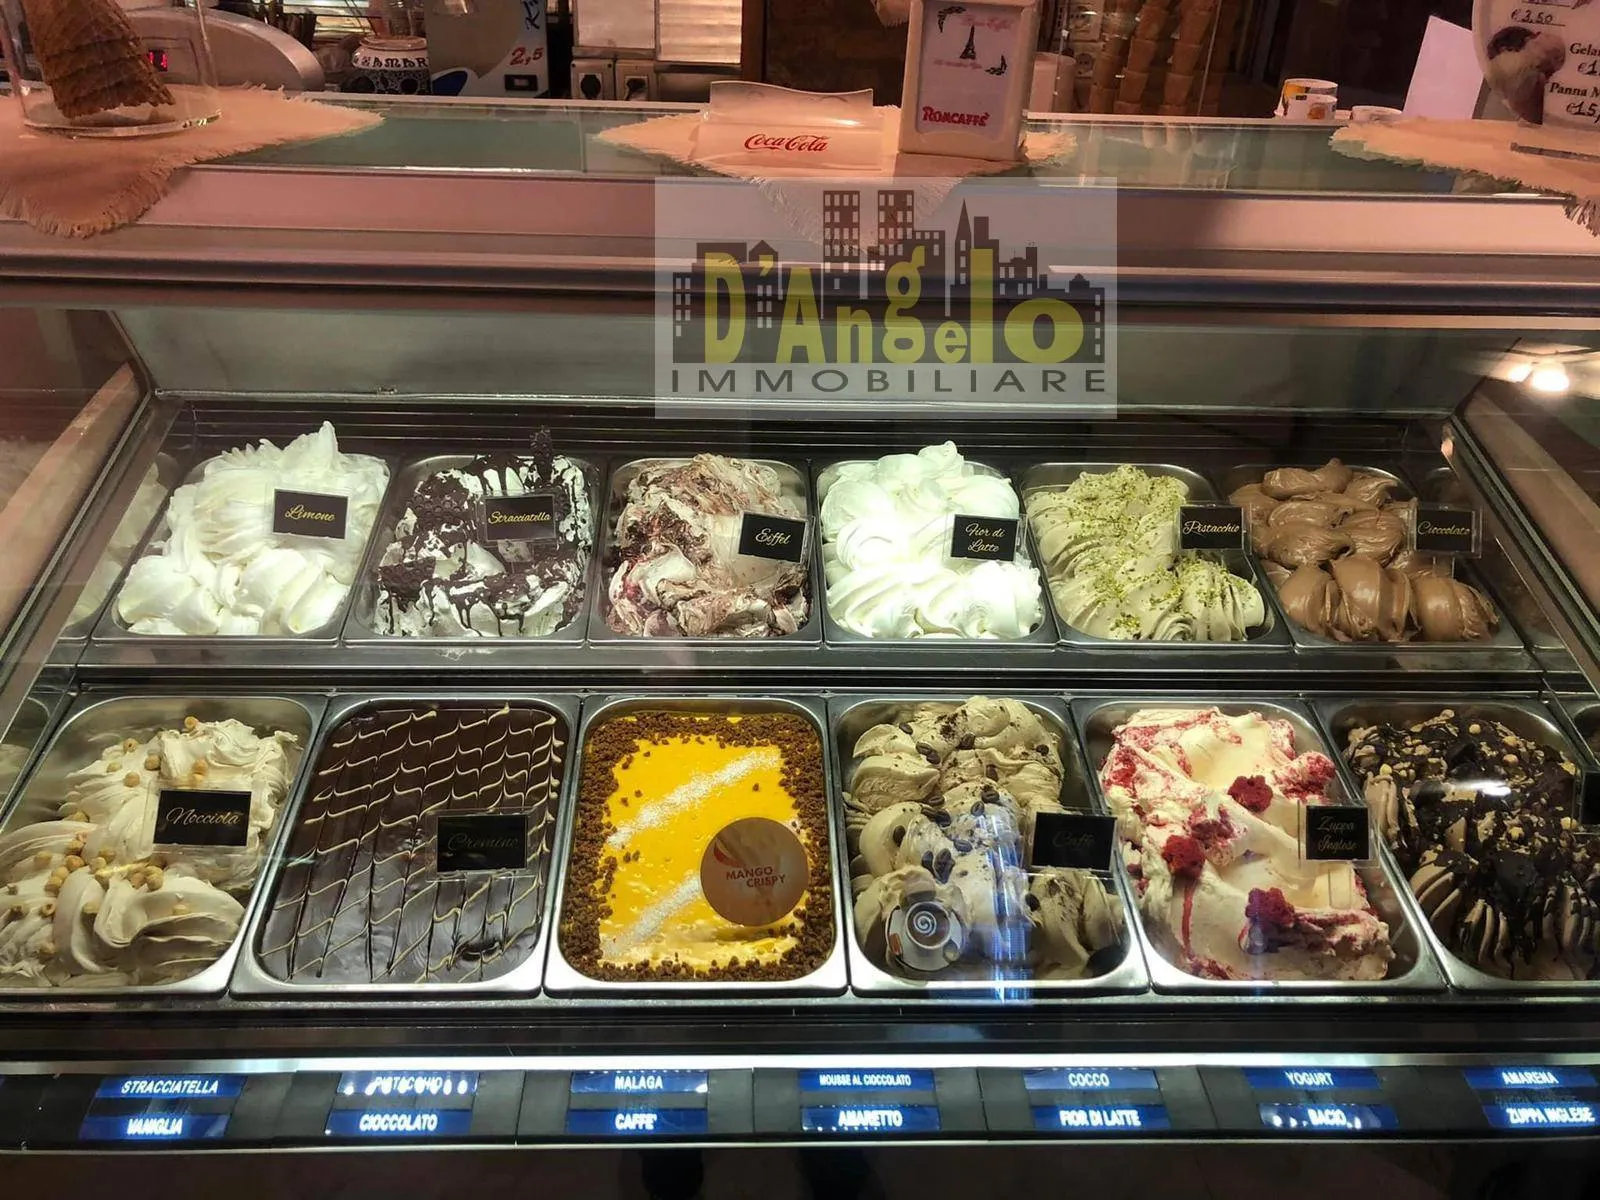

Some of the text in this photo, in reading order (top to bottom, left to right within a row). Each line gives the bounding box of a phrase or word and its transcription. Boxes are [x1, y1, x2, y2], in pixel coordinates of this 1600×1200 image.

[1569, 42, 1600, 57] Gela
[372, 56, 429, 69] AMAR
[1549, 81, 1588, 97] Panna
[284, 503, 336, 522] Limone
[965, 522, 1006, 538] Fior di
[1182, 520, 1240, 535] Pistacchio
[755, 527, 792, 546] Eiffel
[967, 538, 1000, 553] Latte
[725, 865, 774, 881] MANGO
[745, 873, 786, 888] CRISPY
[614, 1075, 664, 1090] MALAGA
[863, 1074, 912, 1086] CIOCCOLATO
[1068, 1072, 1110, 1087] COCCO
[1284, 1070, 1334, 1086] YOGURT
[1501, 1071, 1560, 1085] AMARENA
[120, 1079, 219, 1095] STRACCIATELLA
[359, 1113, 438, 1132] CIOCCOLATO
[837, 1109, 904, 1128] AMARETTO
[1059, 1108, 1090, 1127] FIOR
[1103, 1108, 1142, 1127] LATTE
